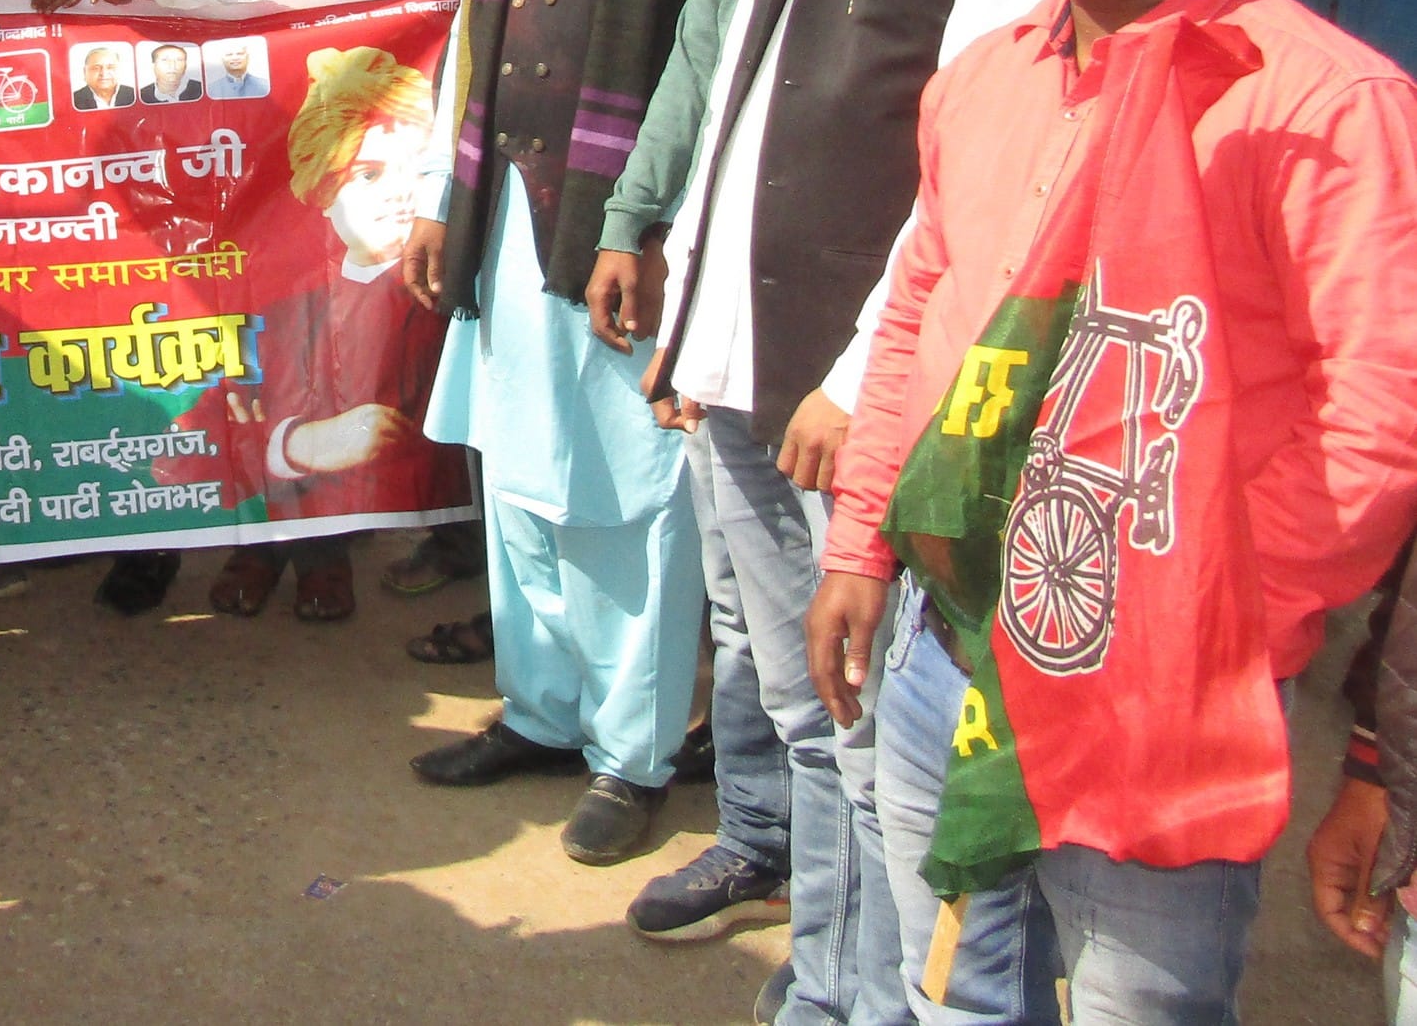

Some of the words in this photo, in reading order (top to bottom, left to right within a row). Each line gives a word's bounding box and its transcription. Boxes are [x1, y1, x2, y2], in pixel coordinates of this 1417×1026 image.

[176, 128, 246, 179] जी
[48, 241, 248, 290] समाजवादी
[40, 482, 100, 521] पार्टी
[108, 478, 222, 514] सोनभद्र
